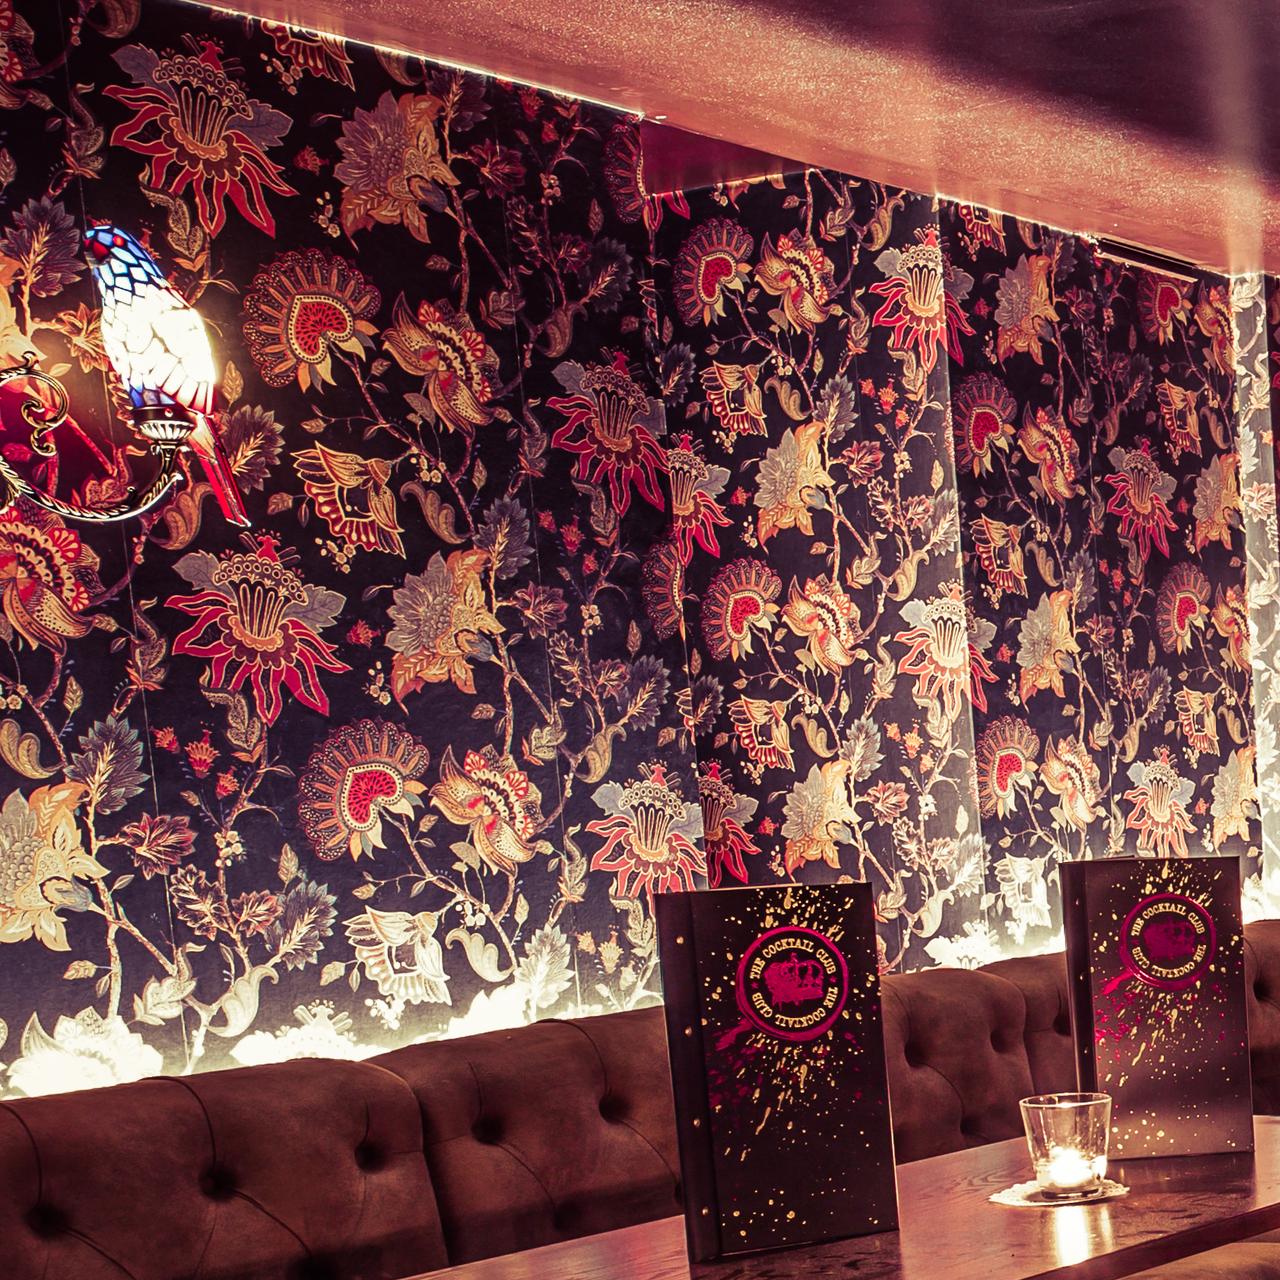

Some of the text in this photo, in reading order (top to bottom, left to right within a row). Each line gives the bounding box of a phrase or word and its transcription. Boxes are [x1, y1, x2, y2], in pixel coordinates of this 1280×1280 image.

[1131, 903, 1205, 936] THE COCKTAIL CLUB
[750, 938, 836, 979] THE COCKTAIL CLUB
[1132, 945, 1206, 978] THE COCKTAIL CLUB
[752, 987, 838, 1027] THE COCKTAIL CLUB
